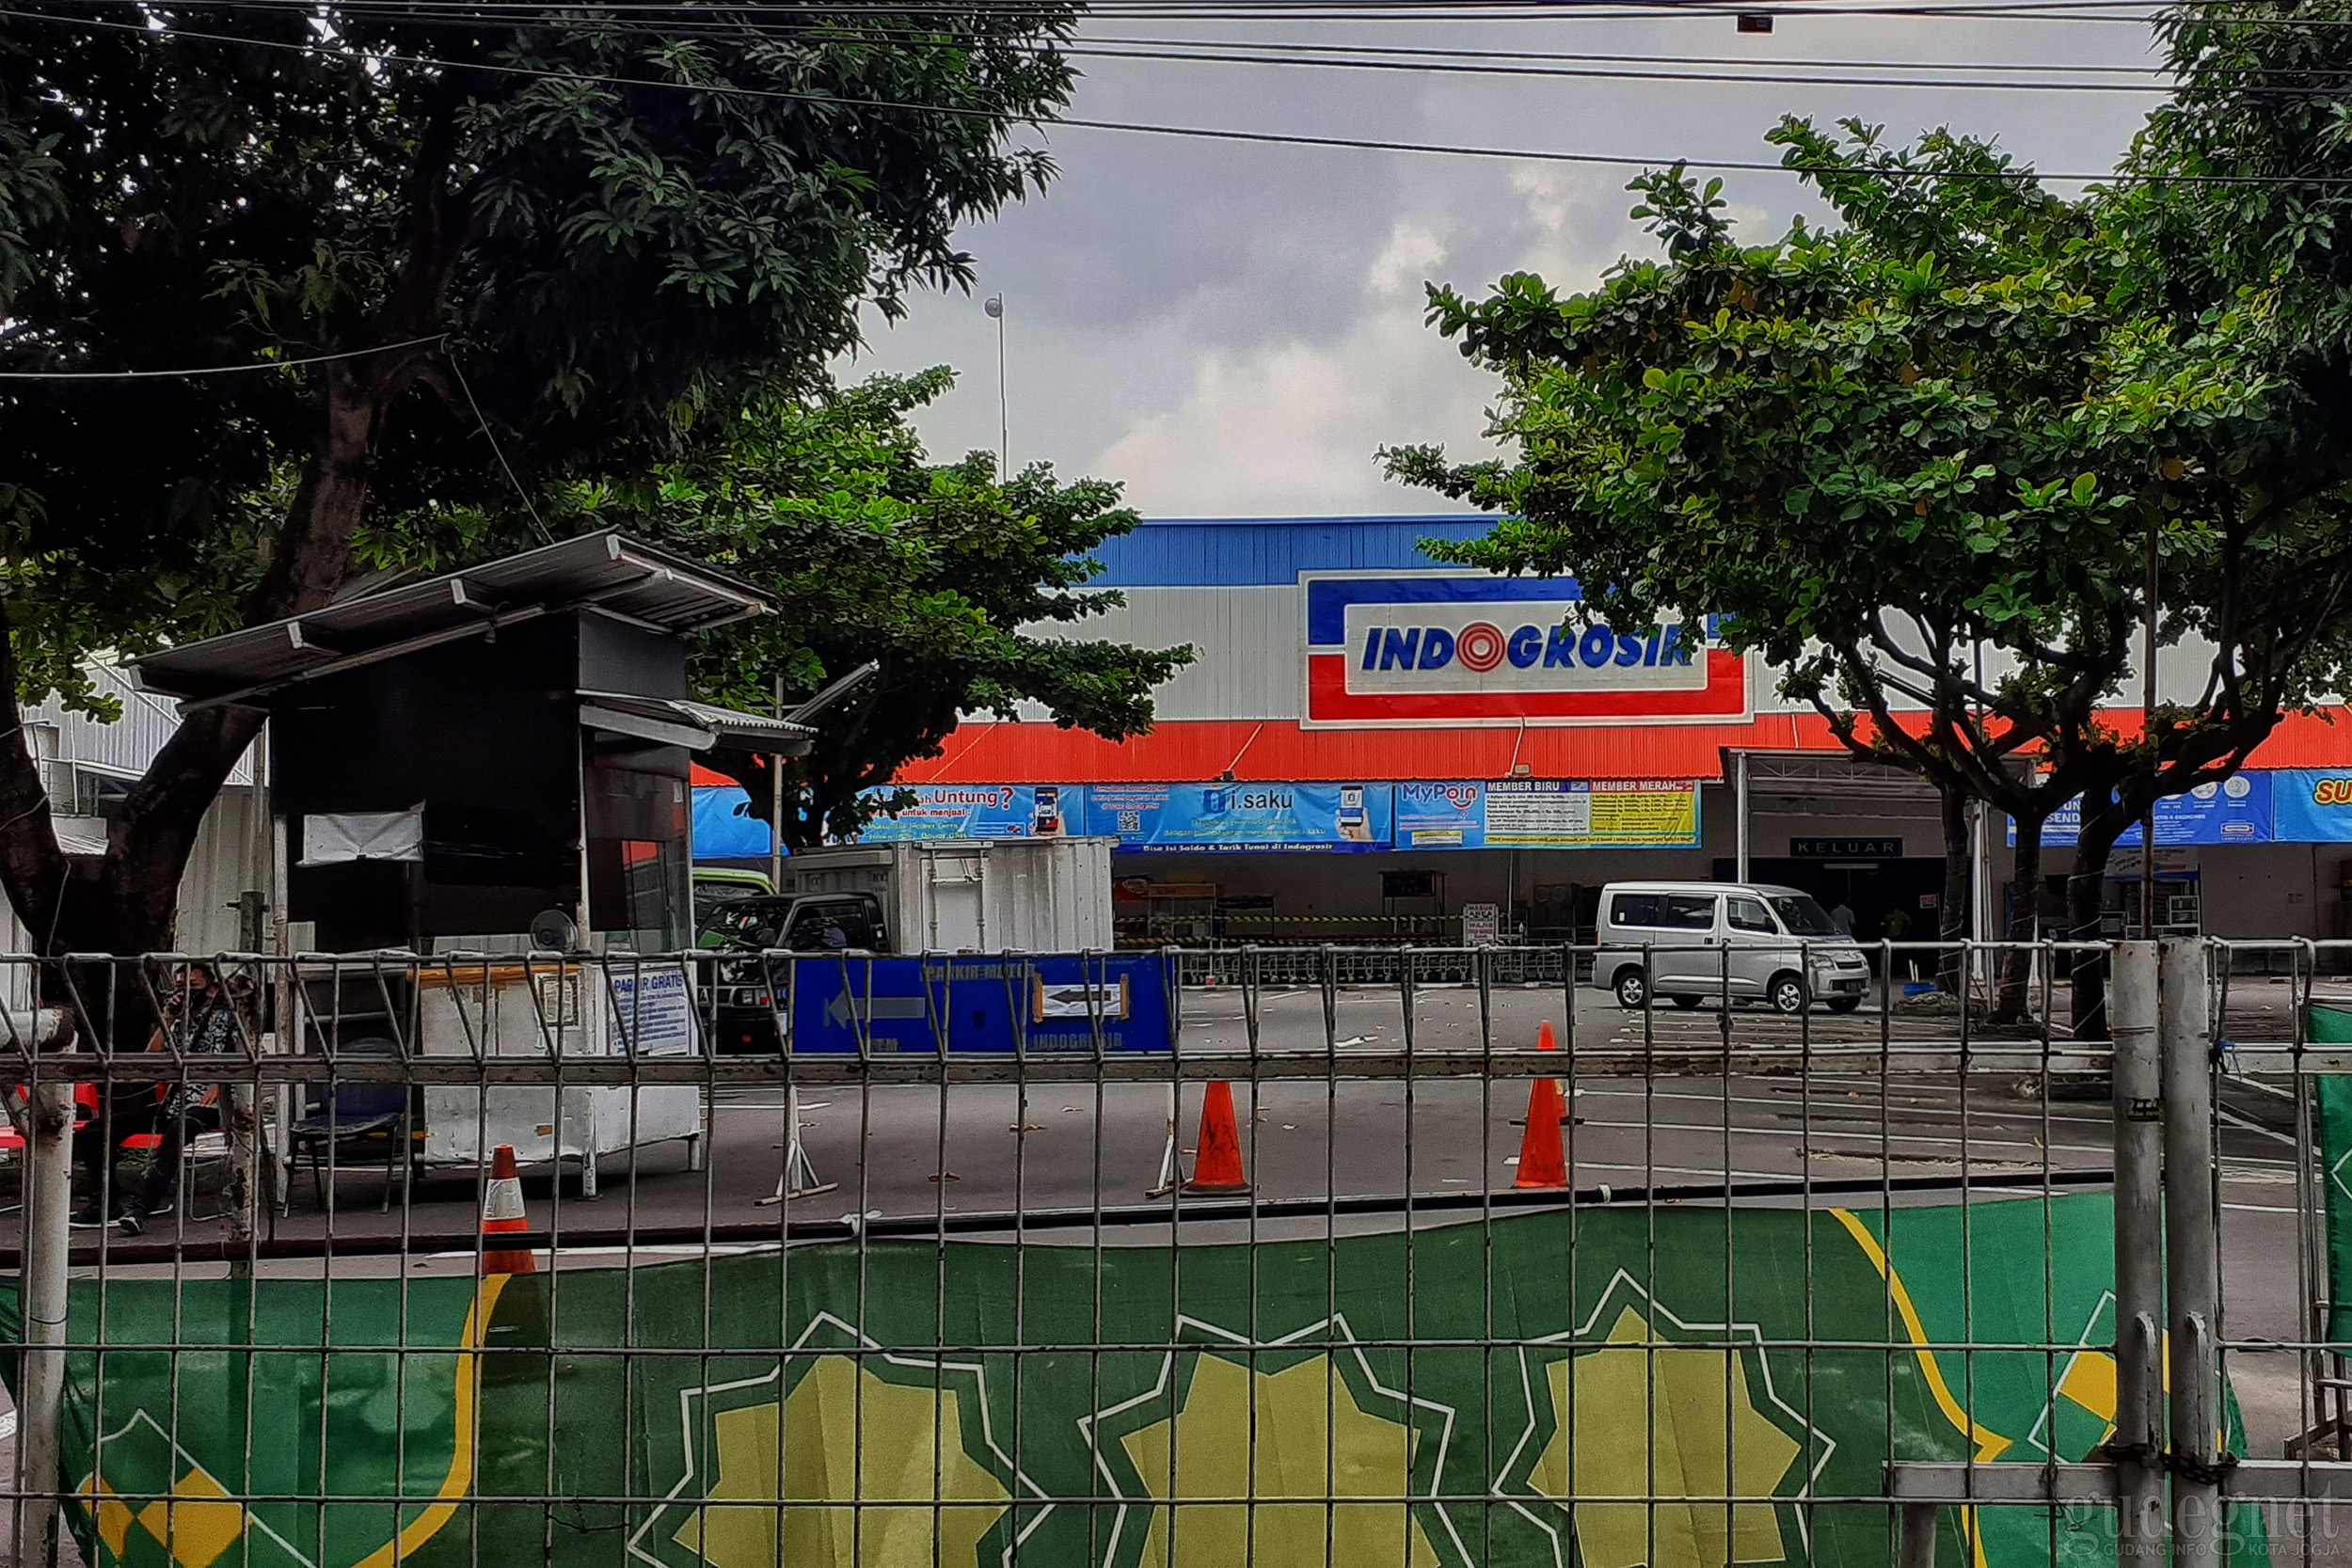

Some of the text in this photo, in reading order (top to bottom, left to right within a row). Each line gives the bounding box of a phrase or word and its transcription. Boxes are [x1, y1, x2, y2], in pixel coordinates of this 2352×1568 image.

[1360, 621, 1693, 673] INDOGROSIR
[1487, 782, 1560, 791] MEMBER BIRU
[1592, 781, 1677, 791] MEMBER MERAH
[1402, 783, 1477, 803] MyPoin
[1231, 790, 1293, 810] i.saku
[902, 808, 928, 816] untuk
[930, 808, 965, 818] menjual
[1284, 843, 1333, 851] Indogrosir
[1798, 842, 1895, 853] KELUAR
[614, 974, 683, 991] PARIR GRATIS
